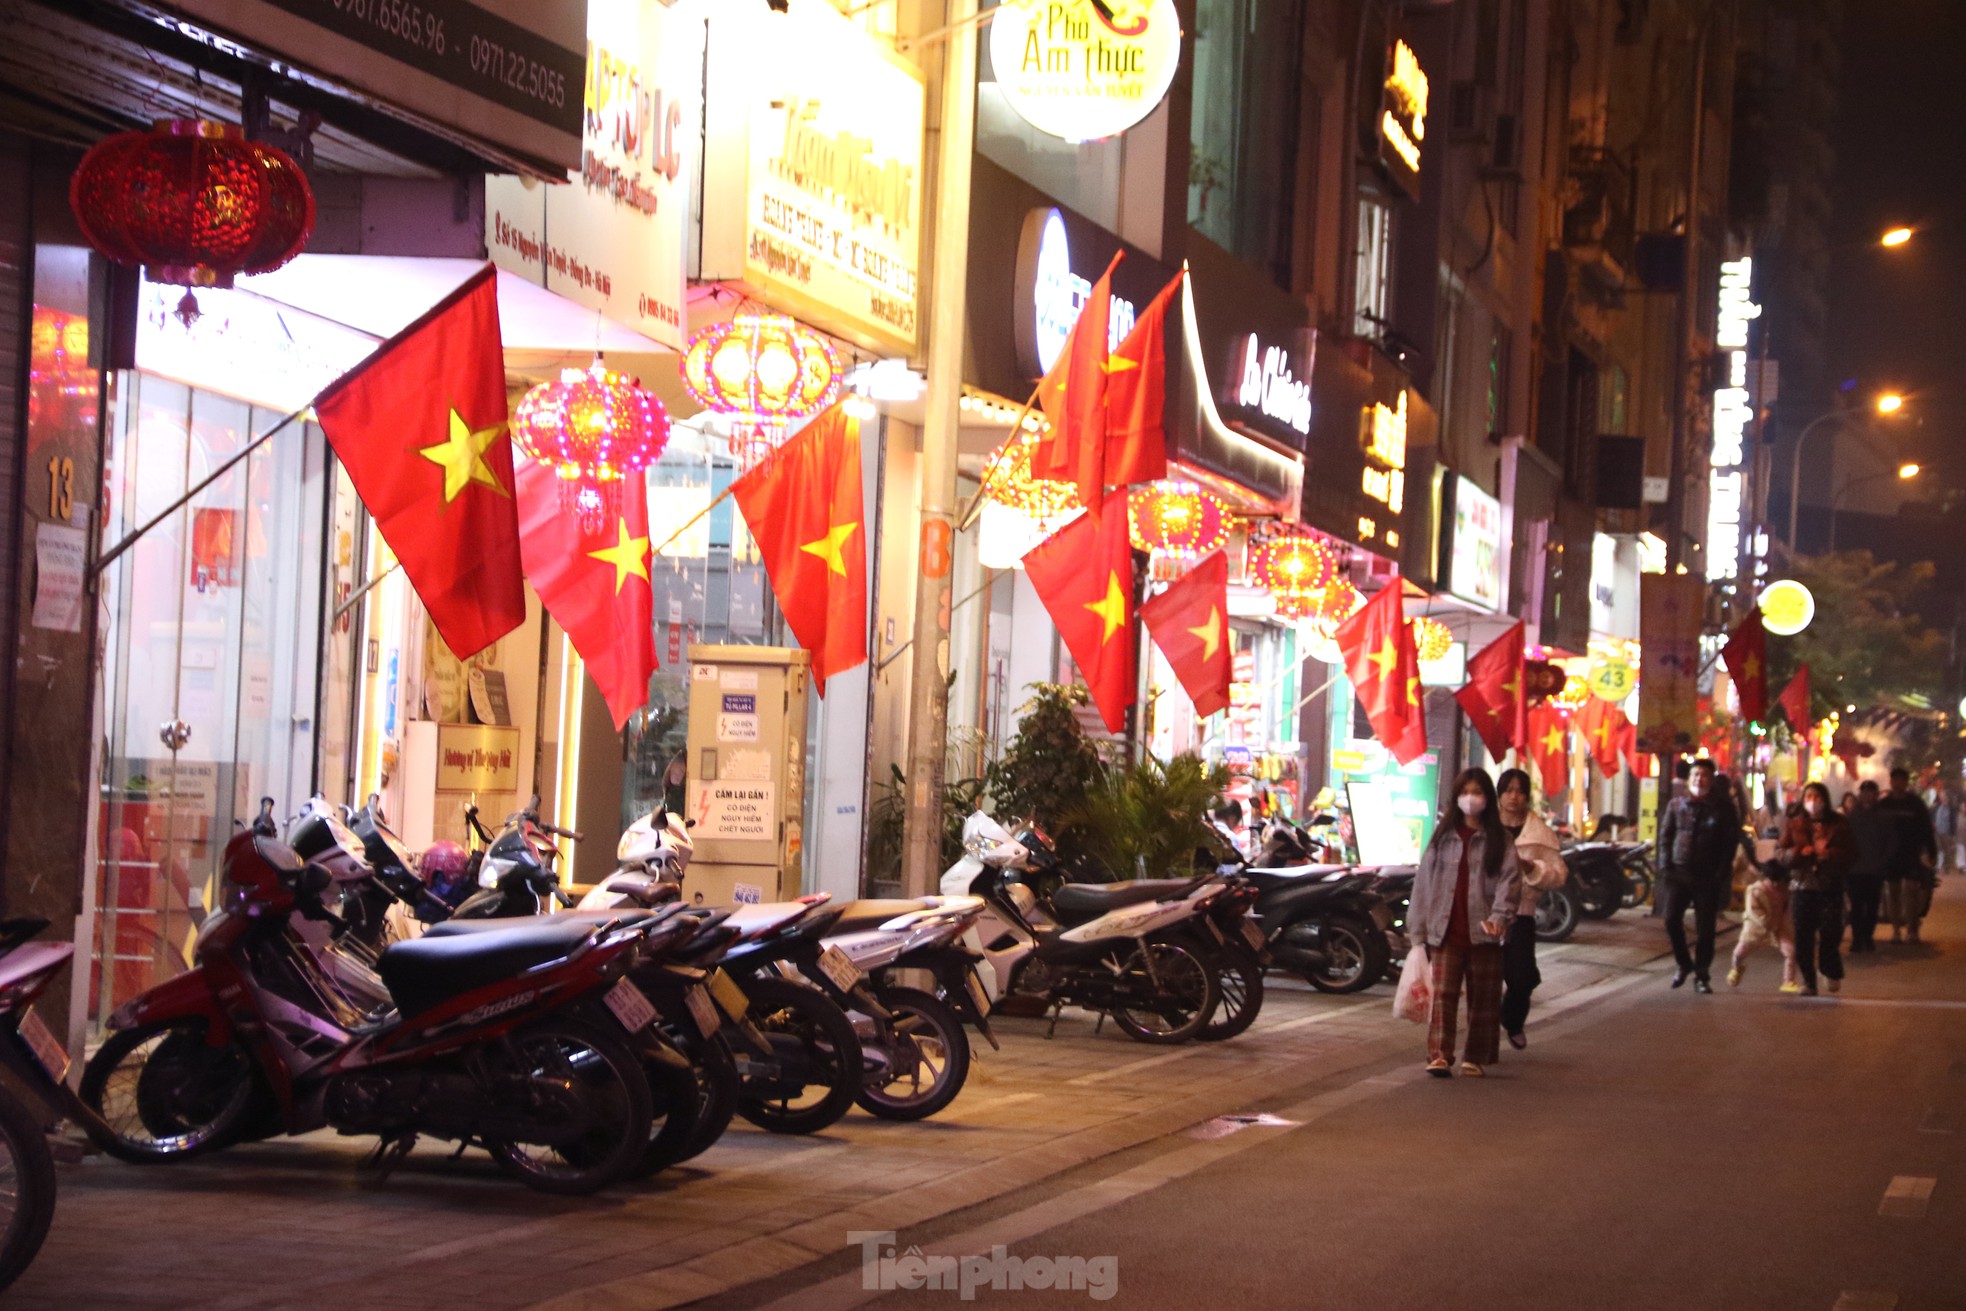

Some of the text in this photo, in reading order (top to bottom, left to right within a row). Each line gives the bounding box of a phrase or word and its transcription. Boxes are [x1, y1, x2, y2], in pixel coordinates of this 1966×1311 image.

[469, 34, 566, 109] 0971.22.5055
[48, 455, 75, 520] 13
[1599, 670, 1625, 688] 43
[715, 787, 733, 799] CẤM
[734, 790, 747, 801] LẠI
[739, 803, 757, 813] ĐIỆN
